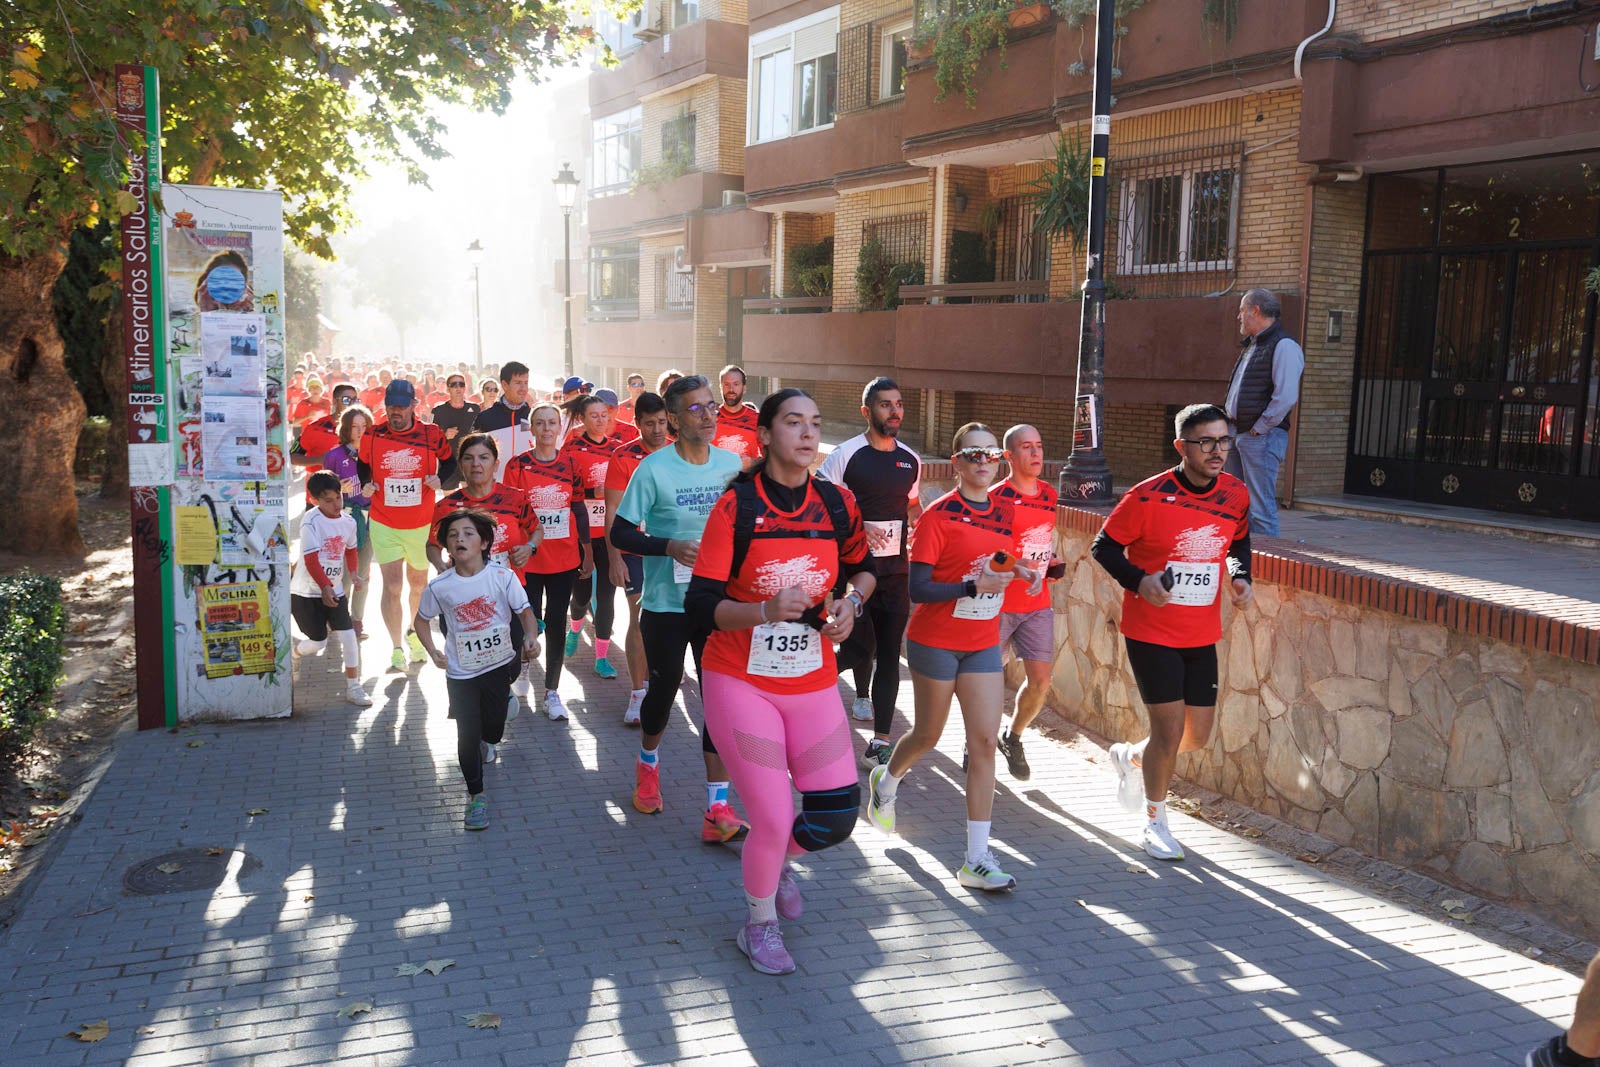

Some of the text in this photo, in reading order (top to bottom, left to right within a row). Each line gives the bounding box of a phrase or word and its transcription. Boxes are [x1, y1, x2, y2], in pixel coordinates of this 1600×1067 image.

[228, 221, 277, 231] Ayuntamiento
[1509, 218, 1520, 237] 2
[152, 226, 160, 245] Ruta
[127, 269, 150, 374] tinerarios
[131, 395, 162, 403] MPS
[384, 457, 418, 465] carrera
[390, 485, 415, 493] 1134
[530, 492, 566, 501] carrera
[540, 515, 560, 525] 914
[1177, 538, 1222, 548] carrera
[759, 573, 825, 587] carrera
[1174, 572, 1210, 586] 1756
[206, 588, 257, 600] MOLINA
[241, 602, 261, 623] B
[242, 641, 272, 653] 149 €
[465, 634, 501, 652] 1135
[765, 635, 809, 651] 1355
